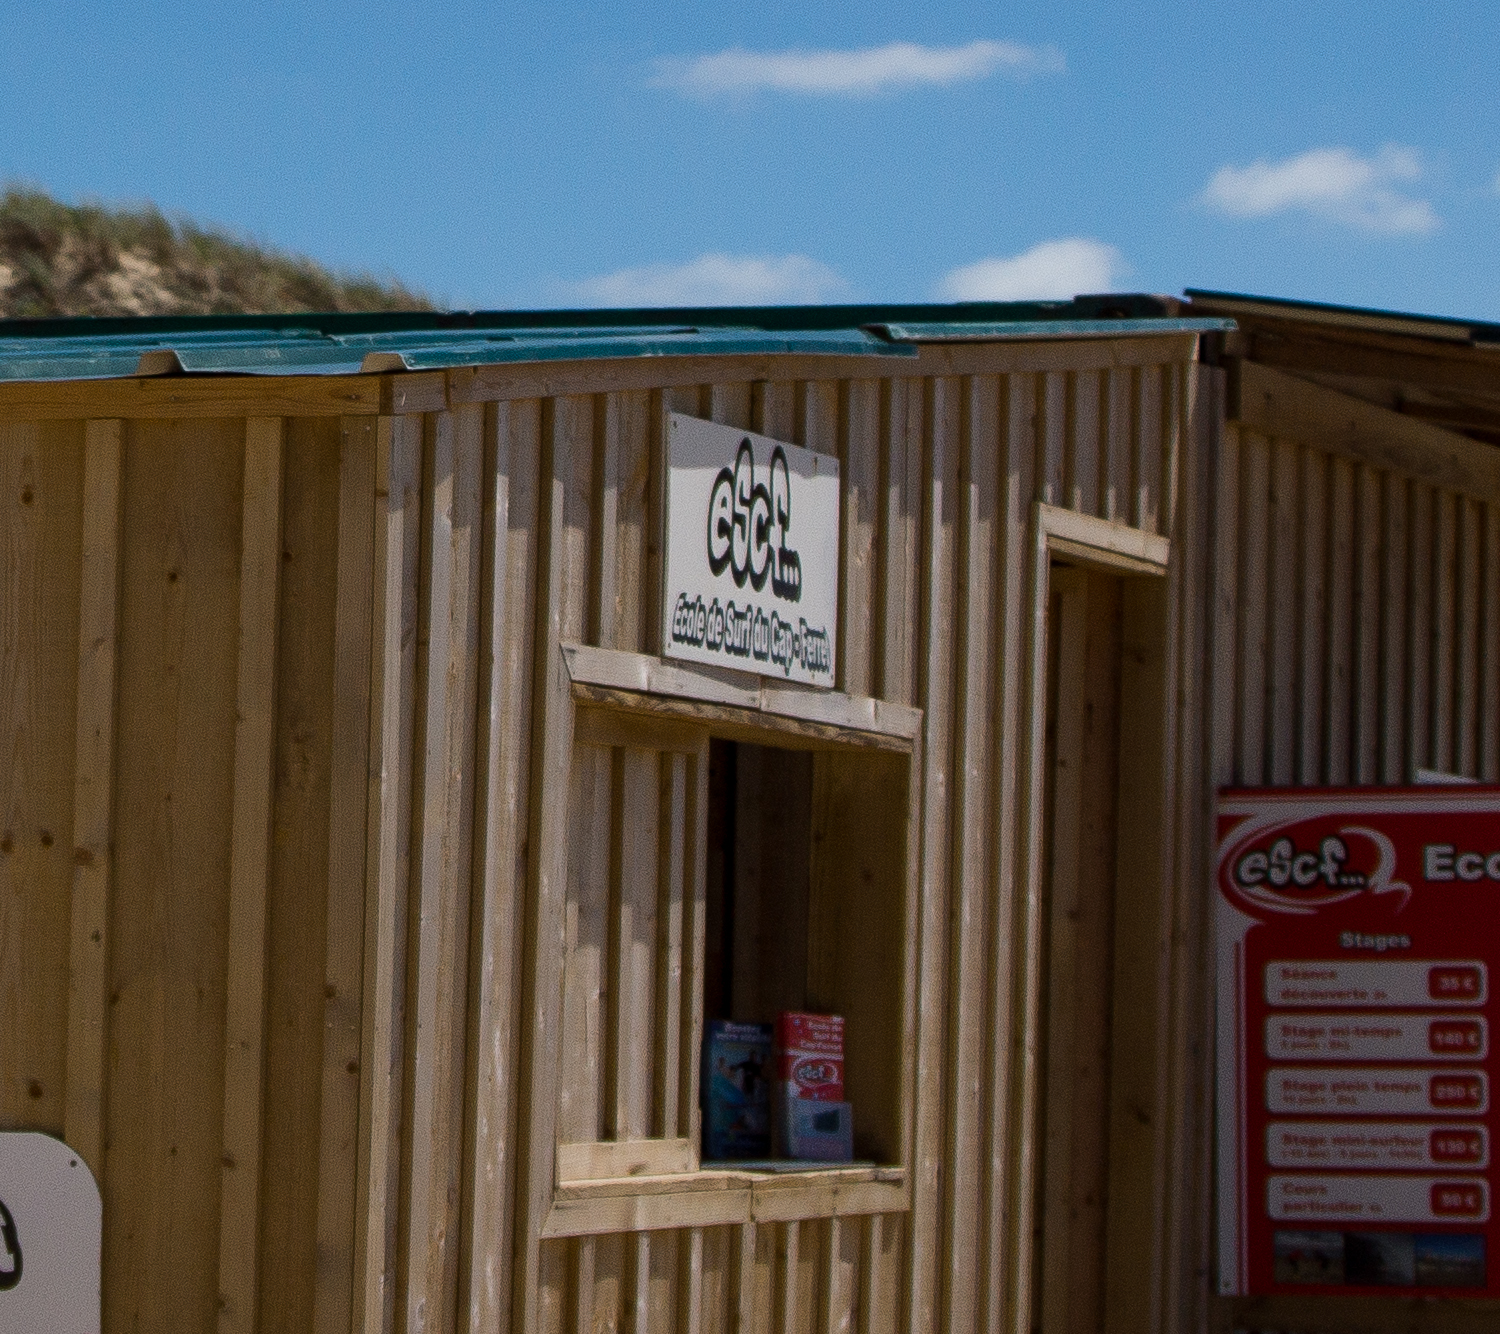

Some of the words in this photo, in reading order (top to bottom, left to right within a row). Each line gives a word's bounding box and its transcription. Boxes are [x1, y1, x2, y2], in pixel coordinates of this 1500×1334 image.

[672, 592, 707, 649] Ecole
[706, 597, 725, 652] de
[725, 600, 751, 658] Surf
[752, 606, 769, 663] du
[1340, 931, 1412, 951] Stages
